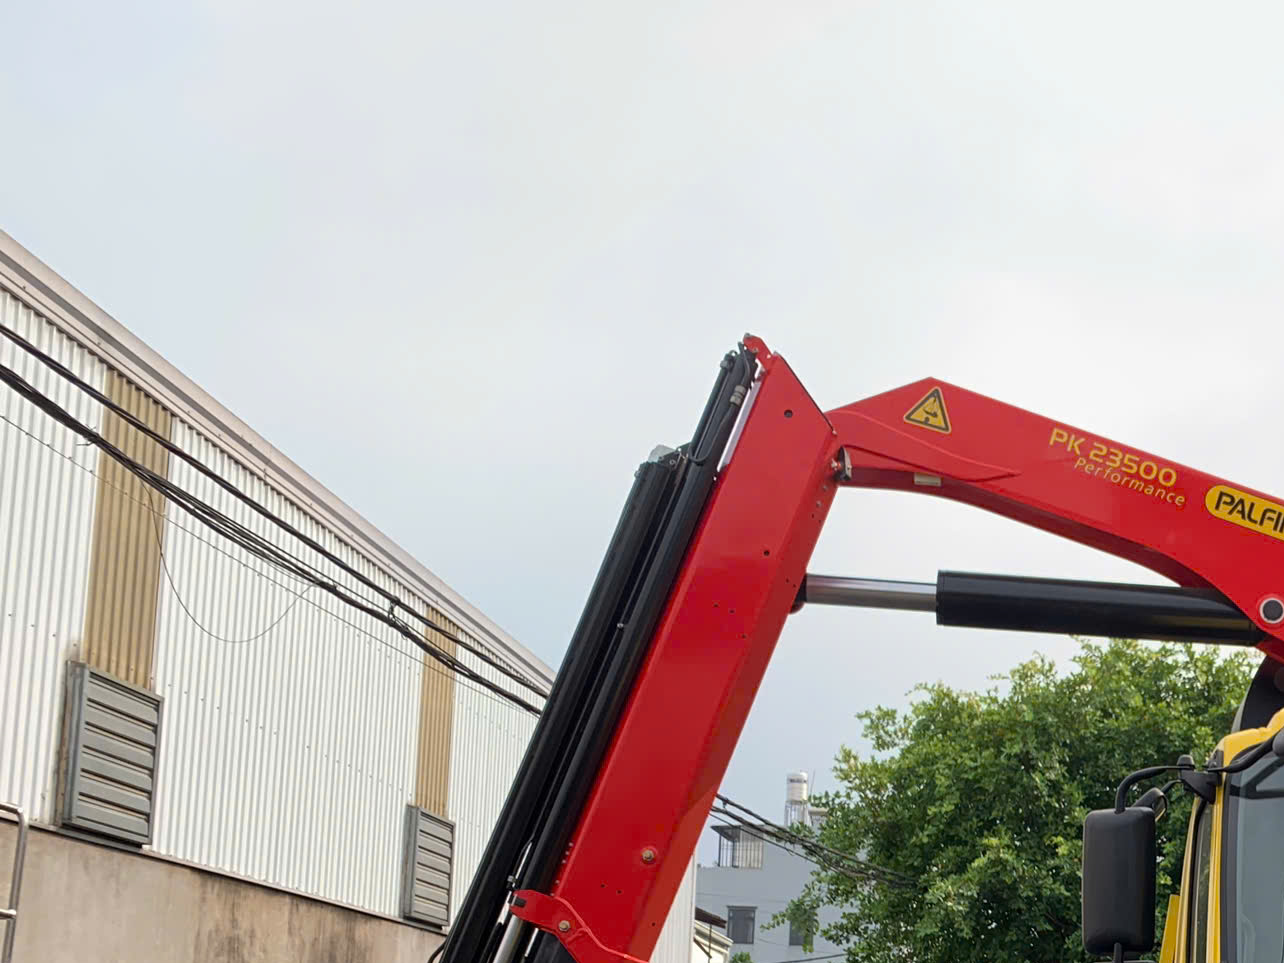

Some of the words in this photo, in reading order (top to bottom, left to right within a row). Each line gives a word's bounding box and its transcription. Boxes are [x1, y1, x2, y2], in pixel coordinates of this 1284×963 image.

[1049, 427, 1086, 456] PK
[1089, 441, 1178, 488] 23500
[1074, 457, 1186, 506] Performance
